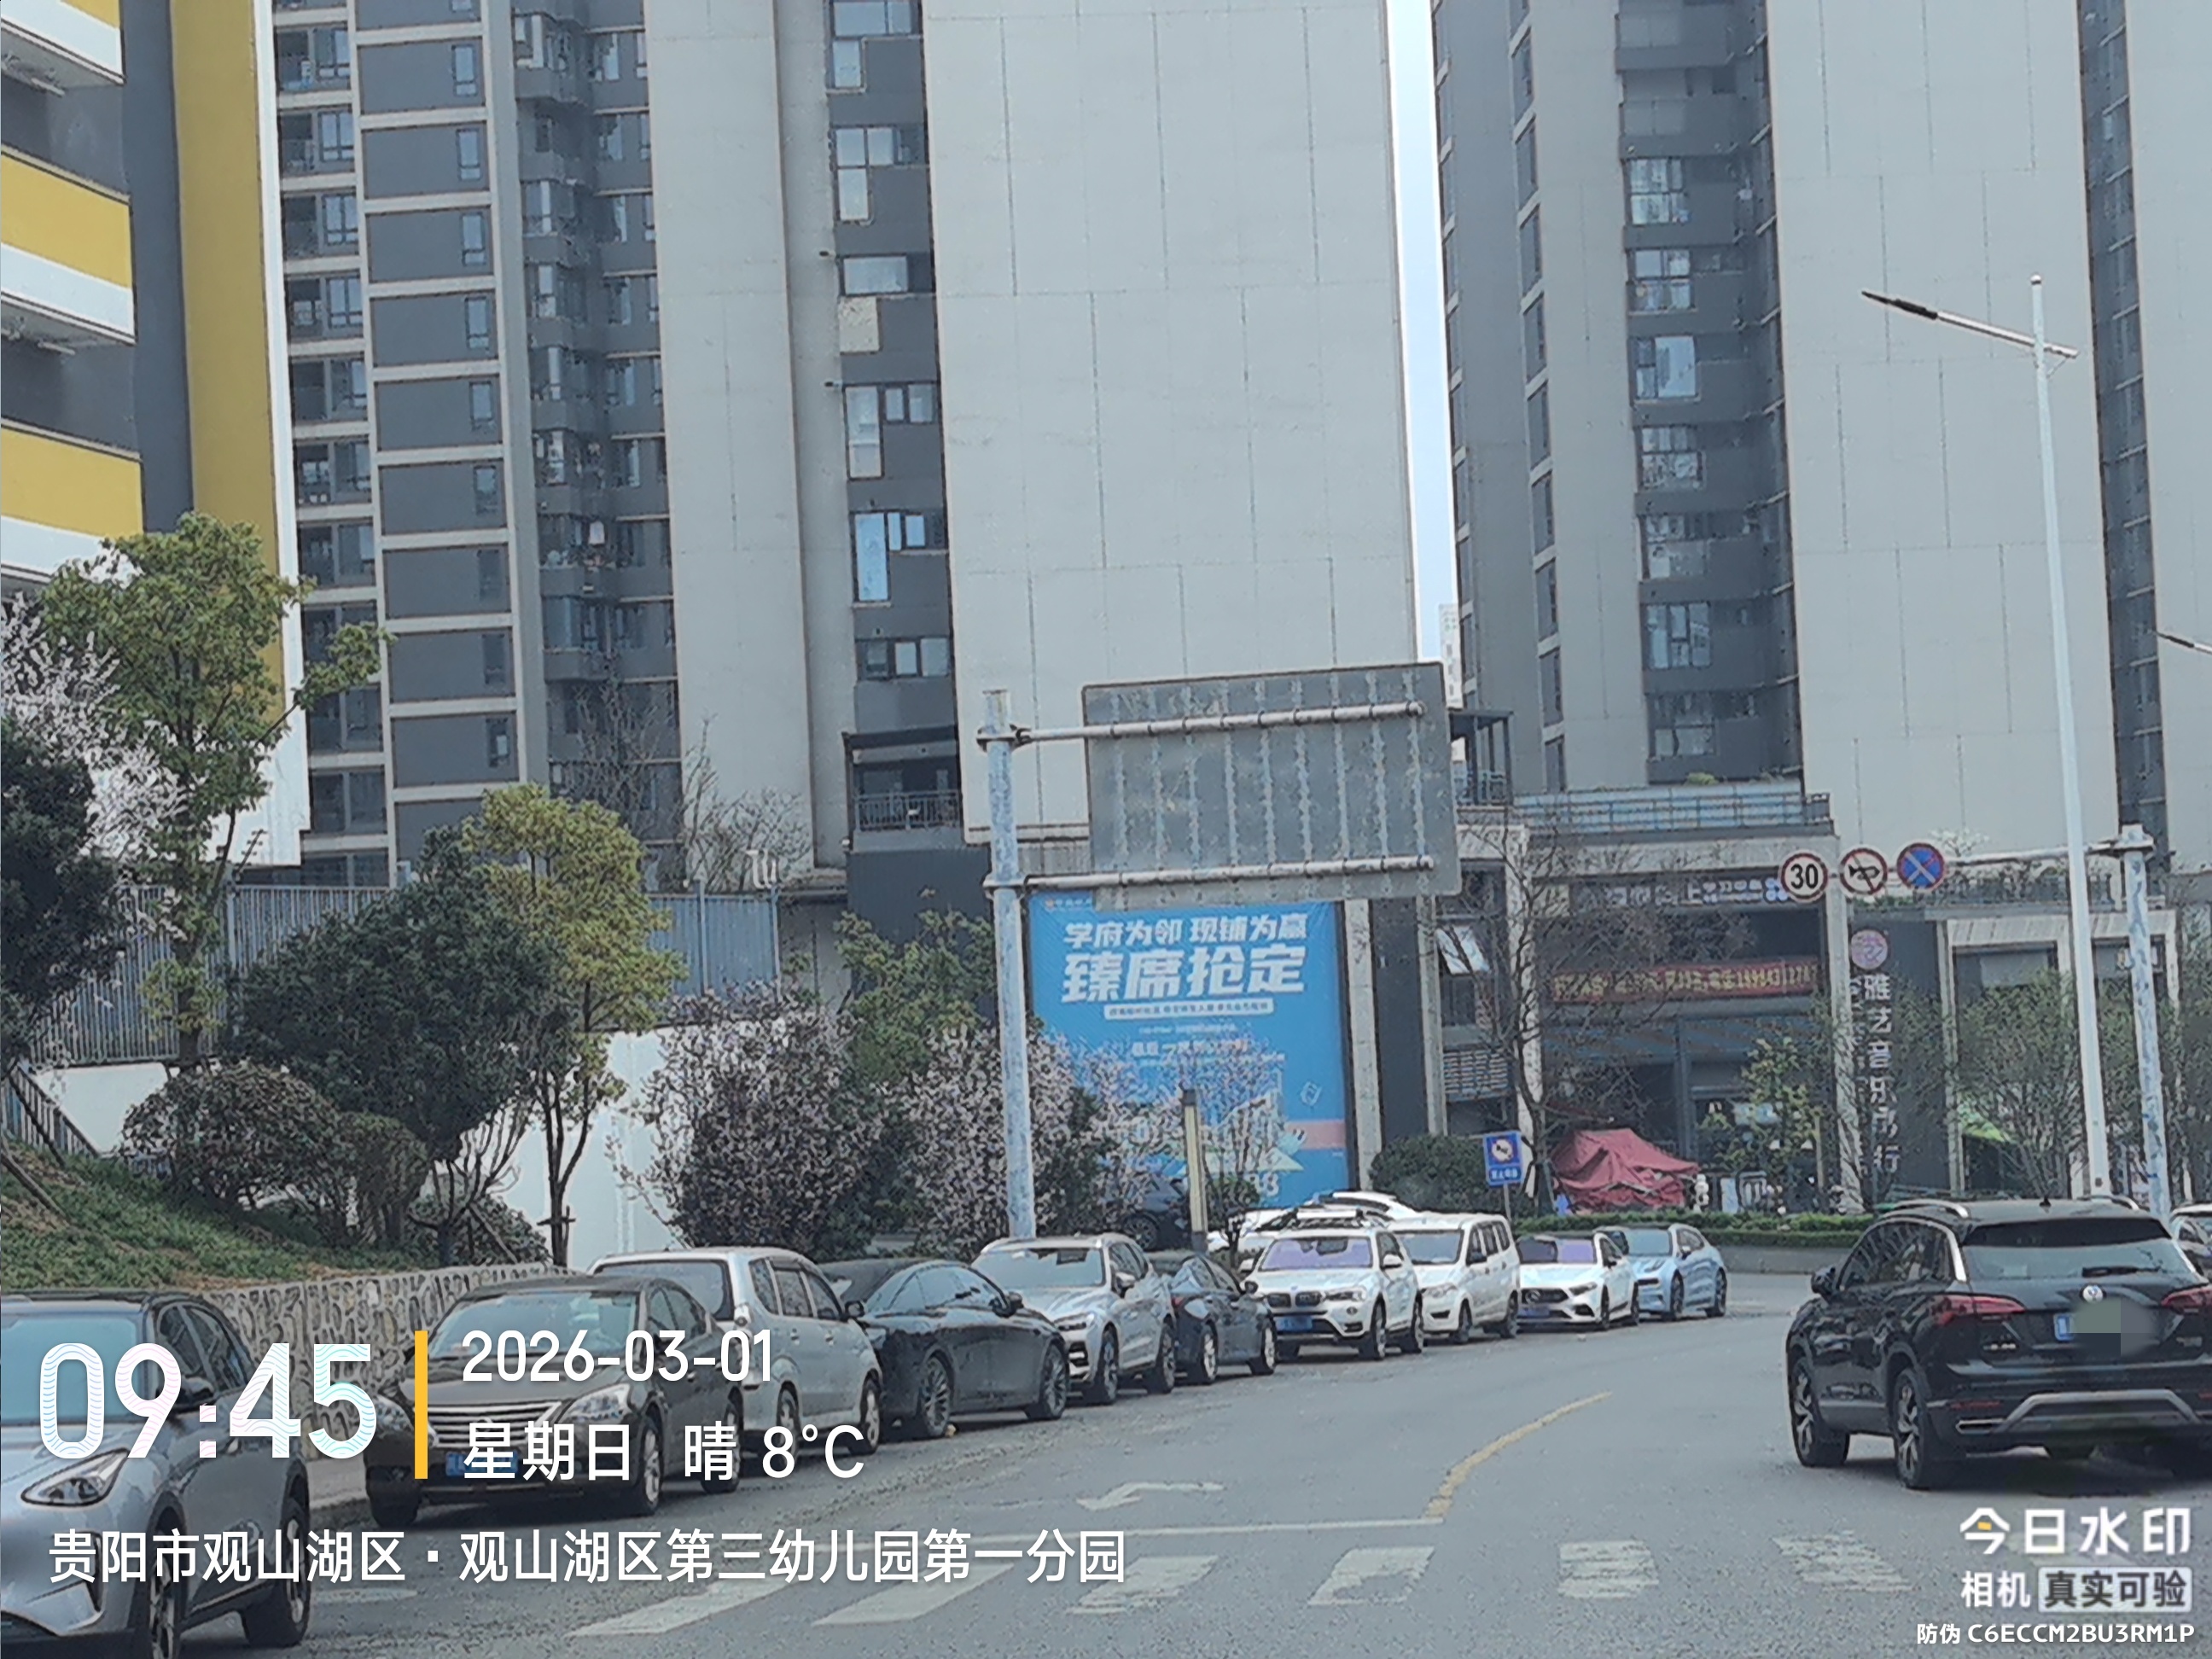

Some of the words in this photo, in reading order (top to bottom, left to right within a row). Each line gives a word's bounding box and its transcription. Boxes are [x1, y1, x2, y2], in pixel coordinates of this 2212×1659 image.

[1790, 864, 1819, 888] 30
[1064, 919, 1183, 948] 学府为邻
[1190, 913, 1308, 944] 现铺为赢
[1062, 944, 1307, 1003] 臻席抢定
